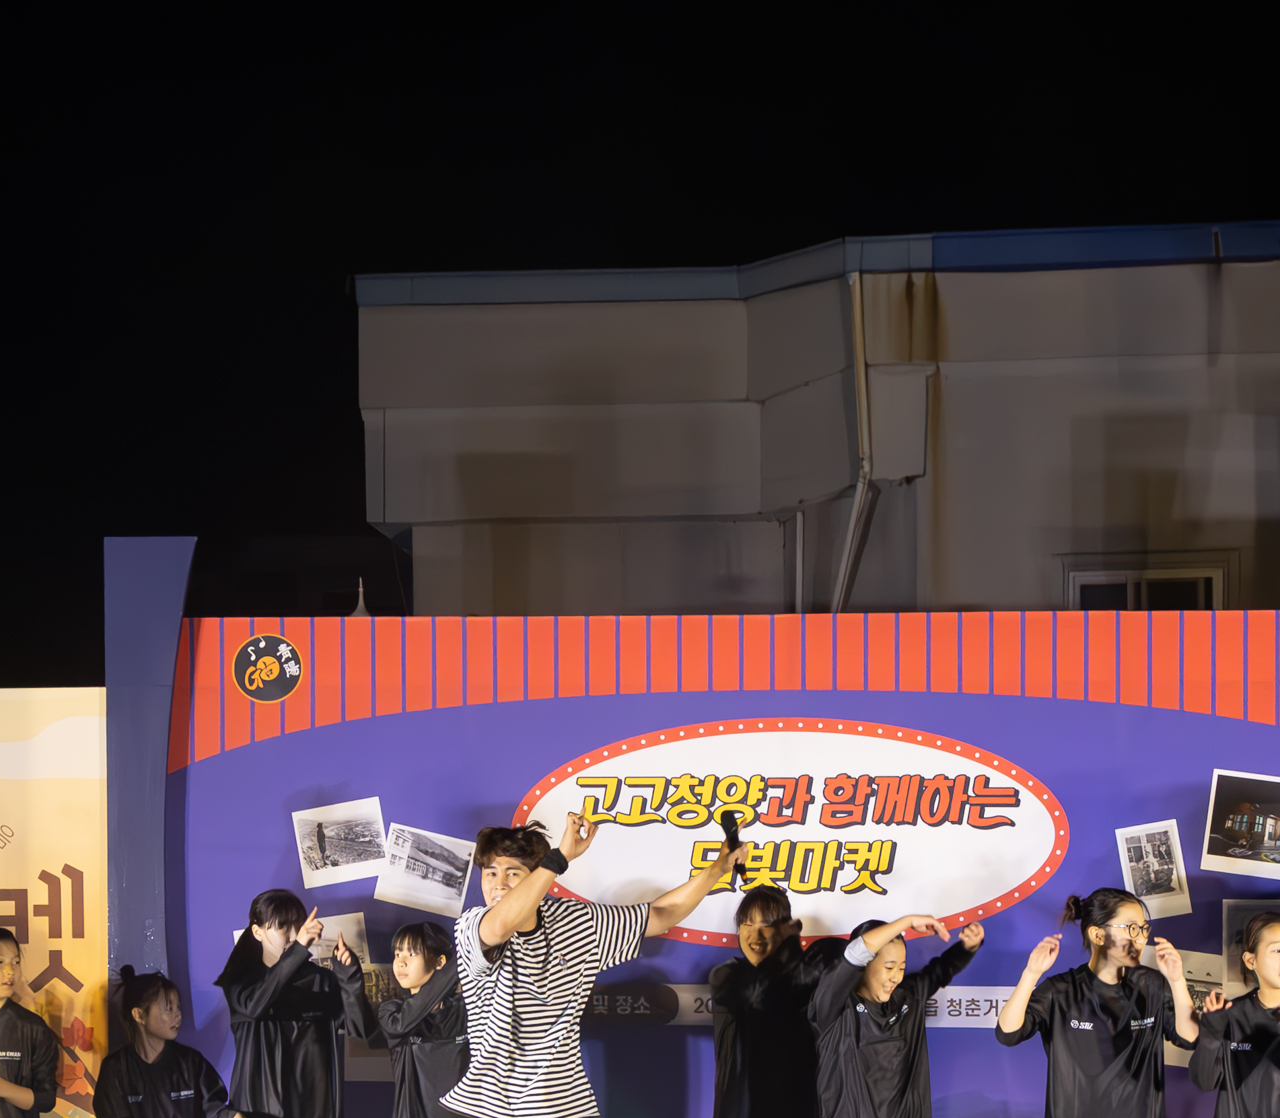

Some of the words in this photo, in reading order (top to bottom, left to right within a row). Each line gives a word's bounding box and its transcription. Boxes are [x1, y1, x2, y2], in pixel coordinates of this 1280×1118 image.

[575, 773, 816, 830] 고고청양과
[819, 773, 1021, 830] 함께하는
[615, 995, 651, 1015] 장소
